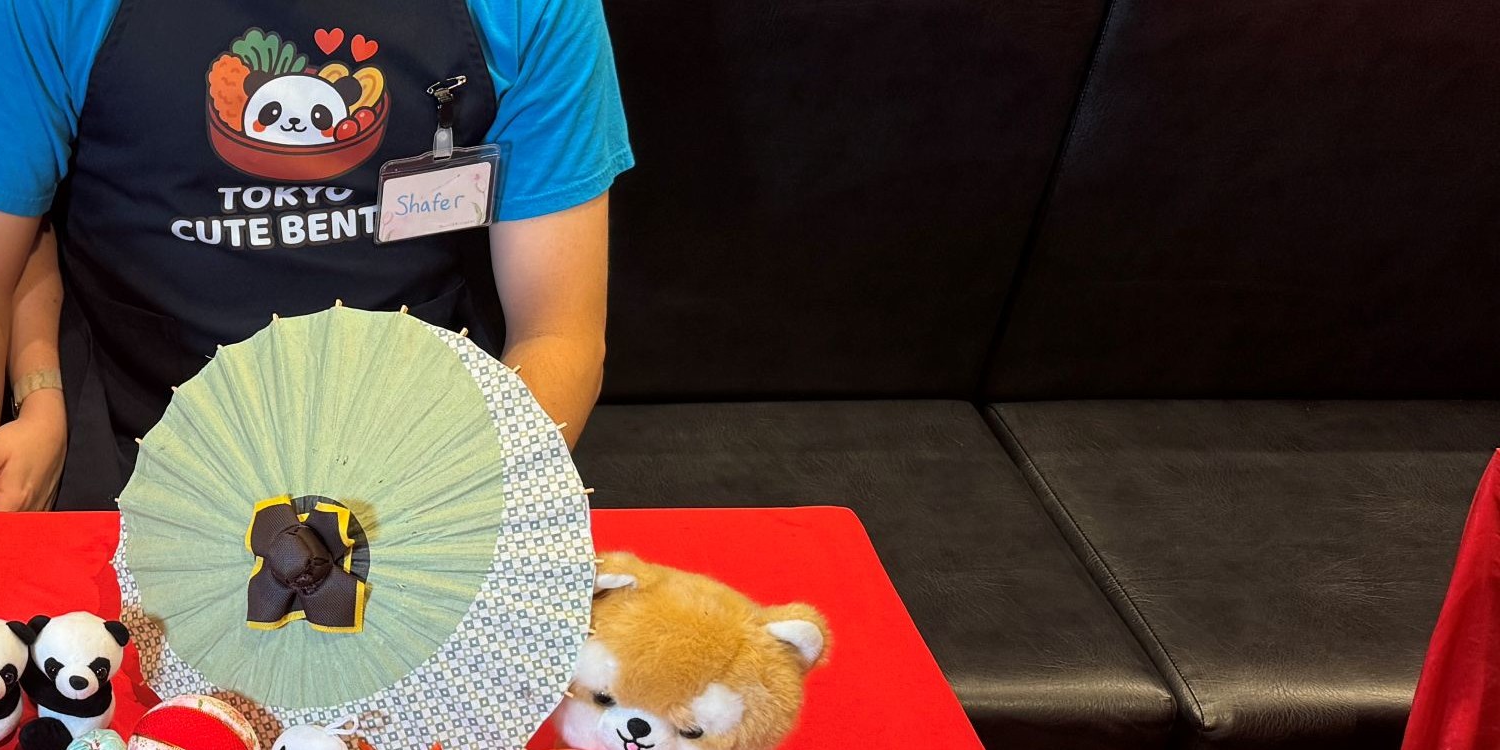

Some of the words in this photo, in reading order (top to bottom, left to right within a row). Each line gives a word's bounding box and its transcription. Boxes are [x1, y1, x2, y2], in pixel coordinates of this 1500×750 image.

[395, 192, 465, 216] Shafer
[171, 217, 271, 247] CUTE
[280, 204, 379, 246] BENT
